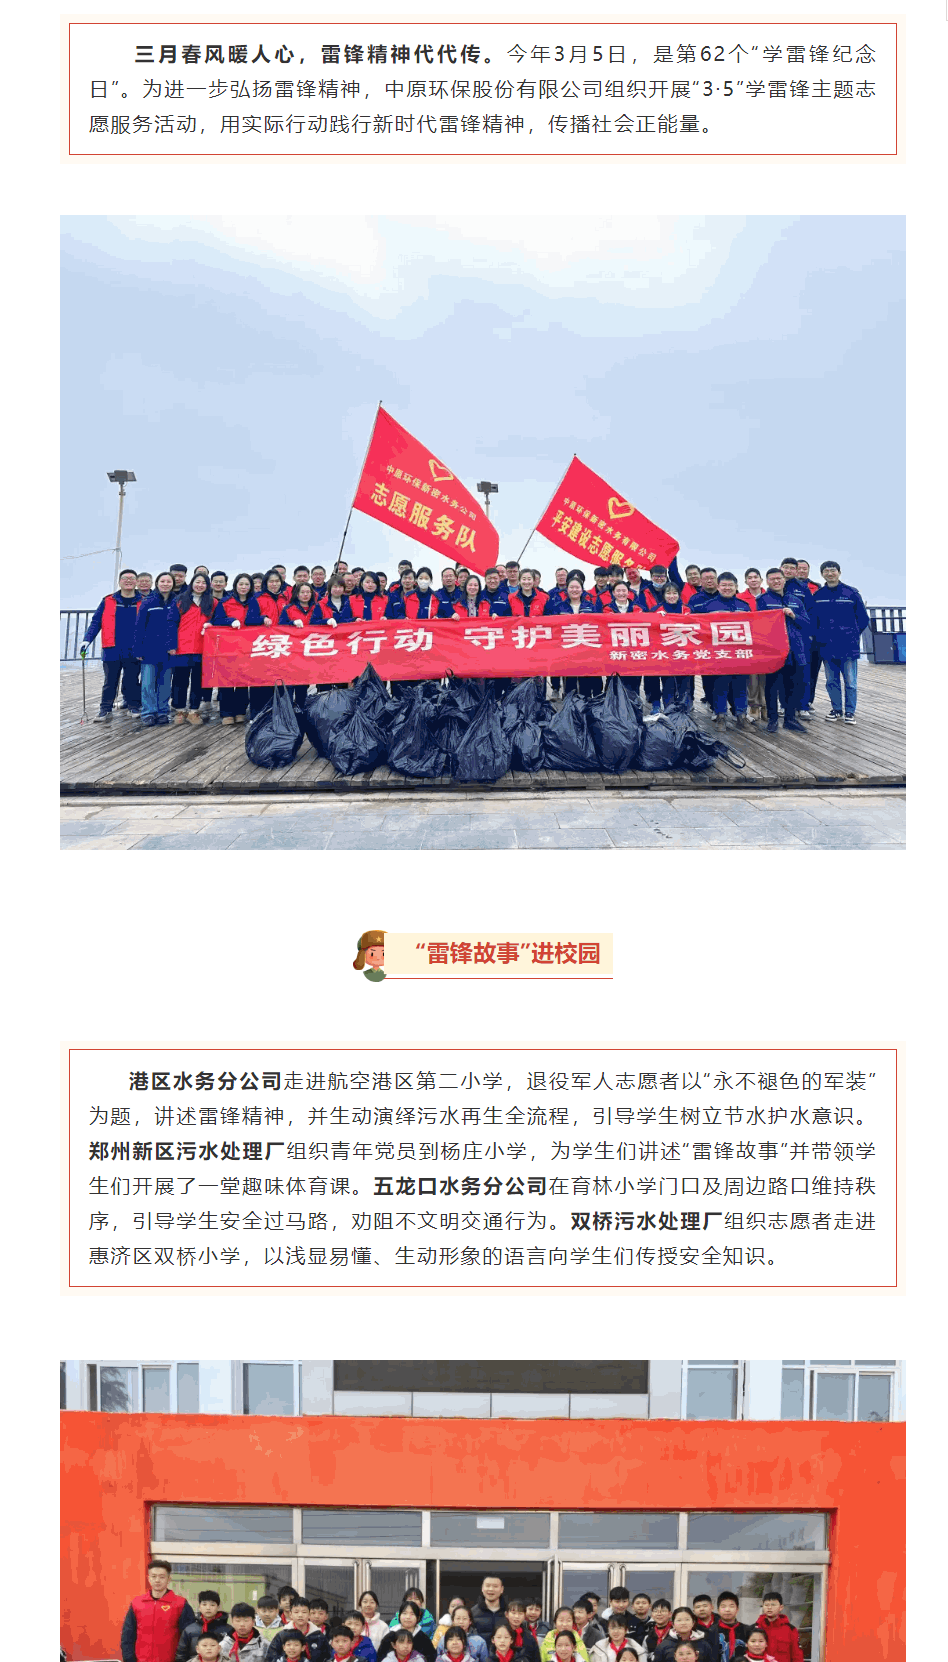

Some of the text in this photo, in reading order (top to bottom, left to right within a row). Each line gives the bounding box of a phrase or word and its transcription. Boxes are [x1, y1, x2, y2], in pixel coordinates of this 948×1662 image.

[370, 482, 477, 553] 志愿服务队
[551, 509, 646, 570] 平安建设志愿服务
[250, 620, 755, 659] 绿色行动 守护美丽家园
[609, 648, 755, 661] 新密水务党支部
